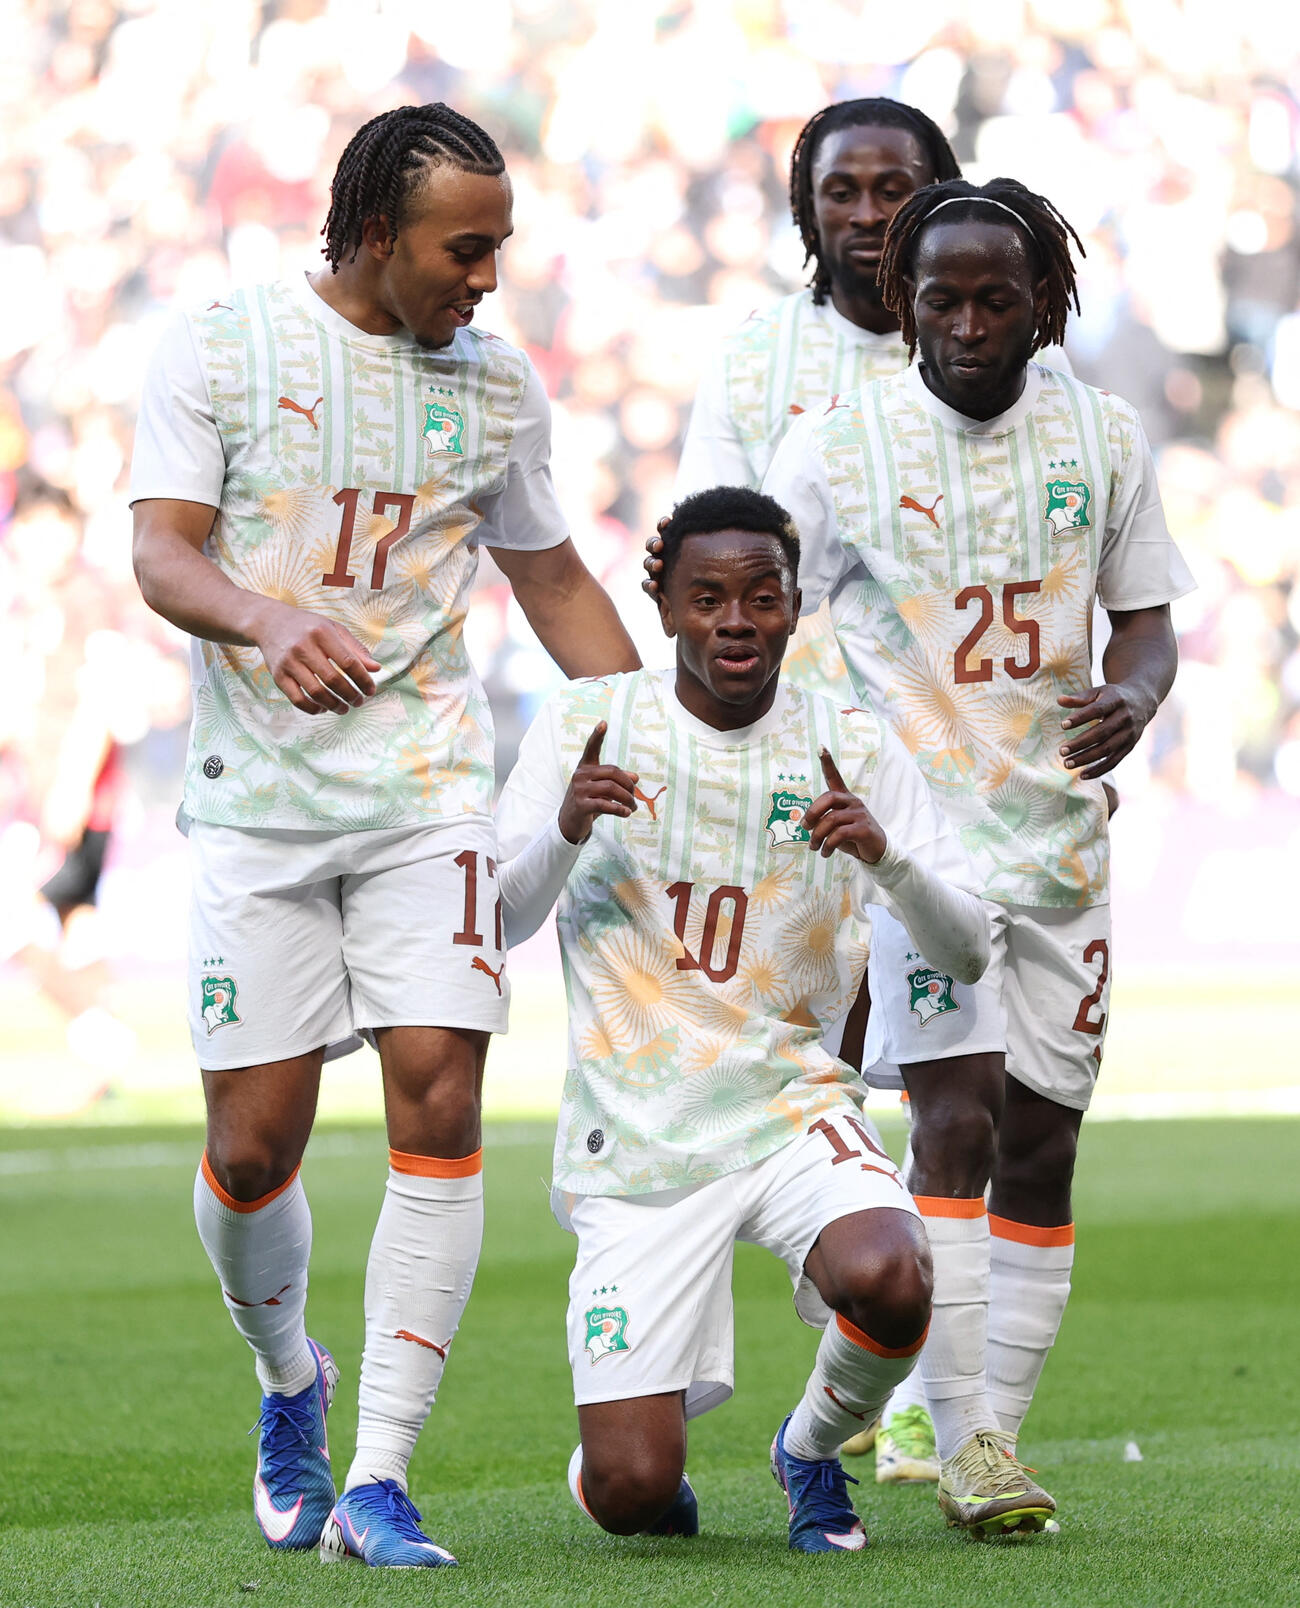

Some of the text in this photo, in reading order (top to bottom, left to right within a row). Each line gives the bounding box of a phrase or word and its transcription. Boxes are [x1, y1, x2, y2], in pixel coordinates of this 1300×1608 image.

[322, 488, 418, 590] 17
[954, 580, 1043, 684] 25
[665, 881, 748, 983] 10
